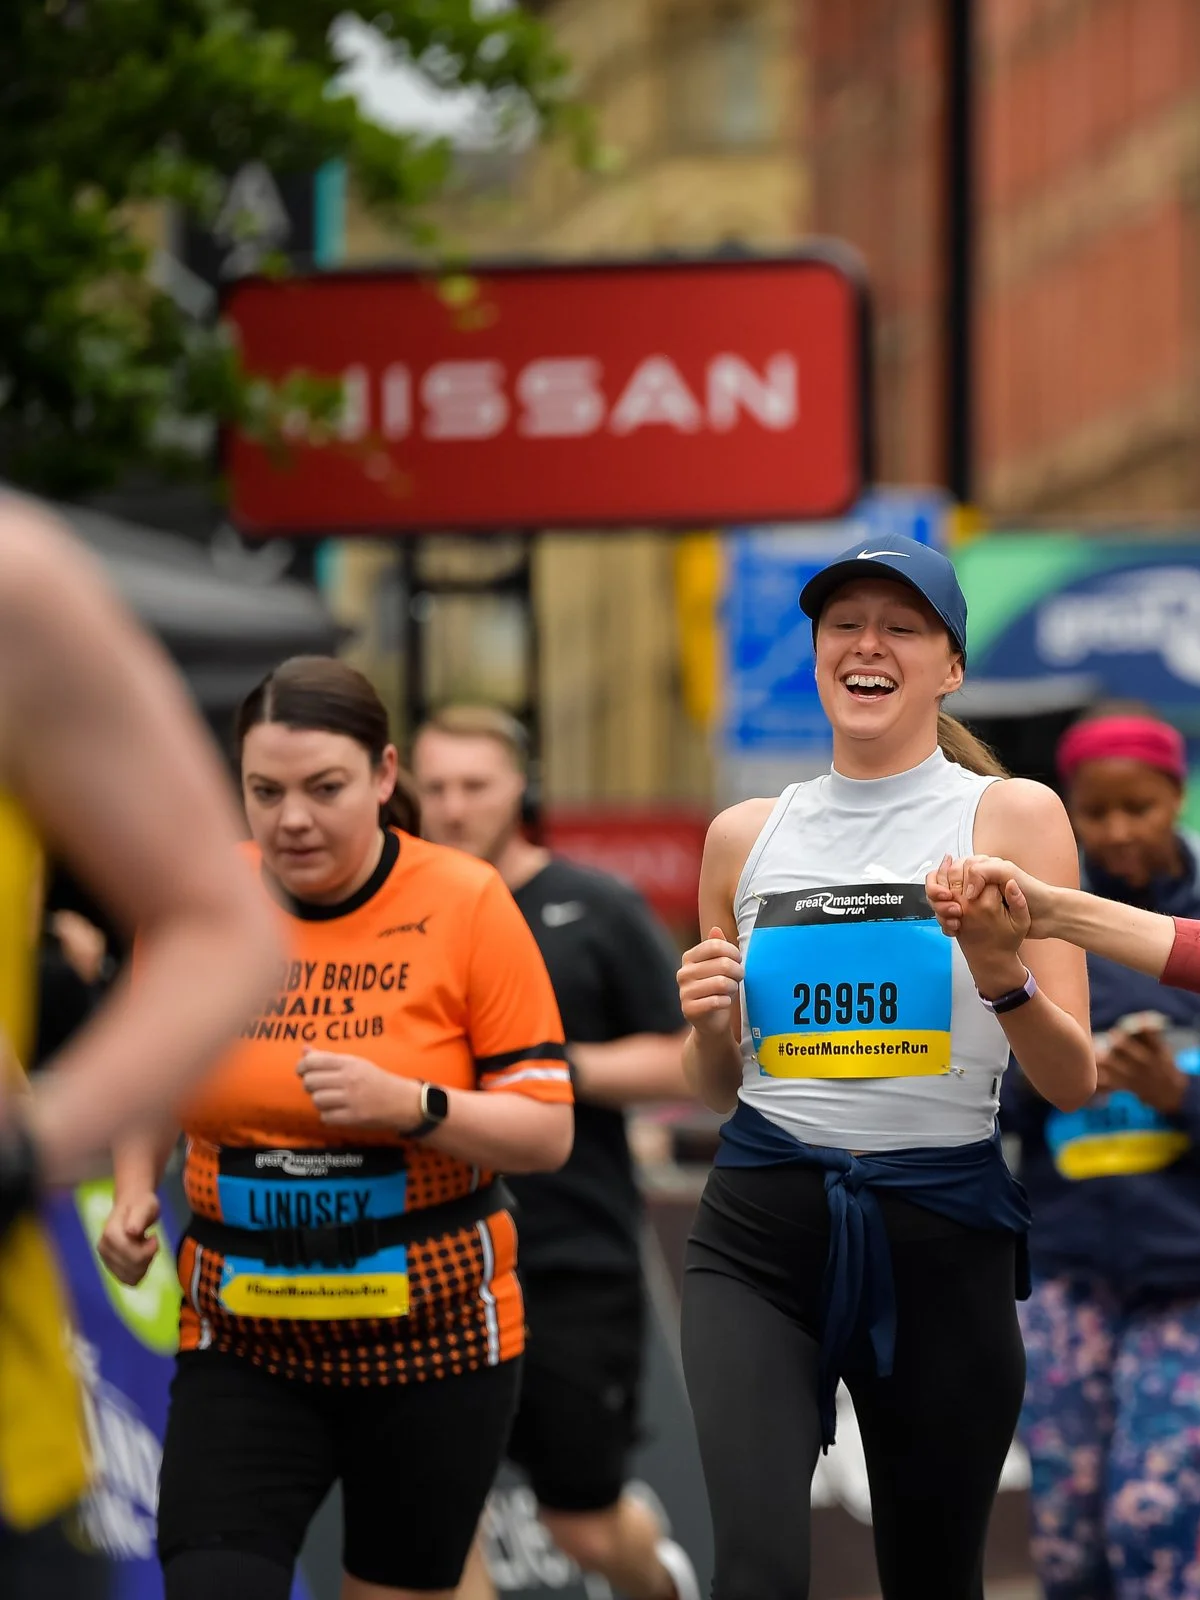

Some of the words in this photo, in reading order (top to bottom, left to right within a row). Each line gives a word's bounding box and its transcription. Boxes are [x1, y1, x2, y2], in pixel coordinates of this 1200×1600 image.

[795, 895, 824, 911] great
[833, 892, 904, 906] manchester
[845, 906, 866, 915] run
[322, 962, 409, 991] BRIDGE
[262, 996, 355, 1018] NAILS
[793, 981, 898, 1025] 26958
[240, 1019, 317, 1042] NNING
[326, 1015, 385, 1041] CLUB
[778, 1040, 929, 1057] #GreatManchesterRun
[249, 1190, 371, 1226] LINDSEY
